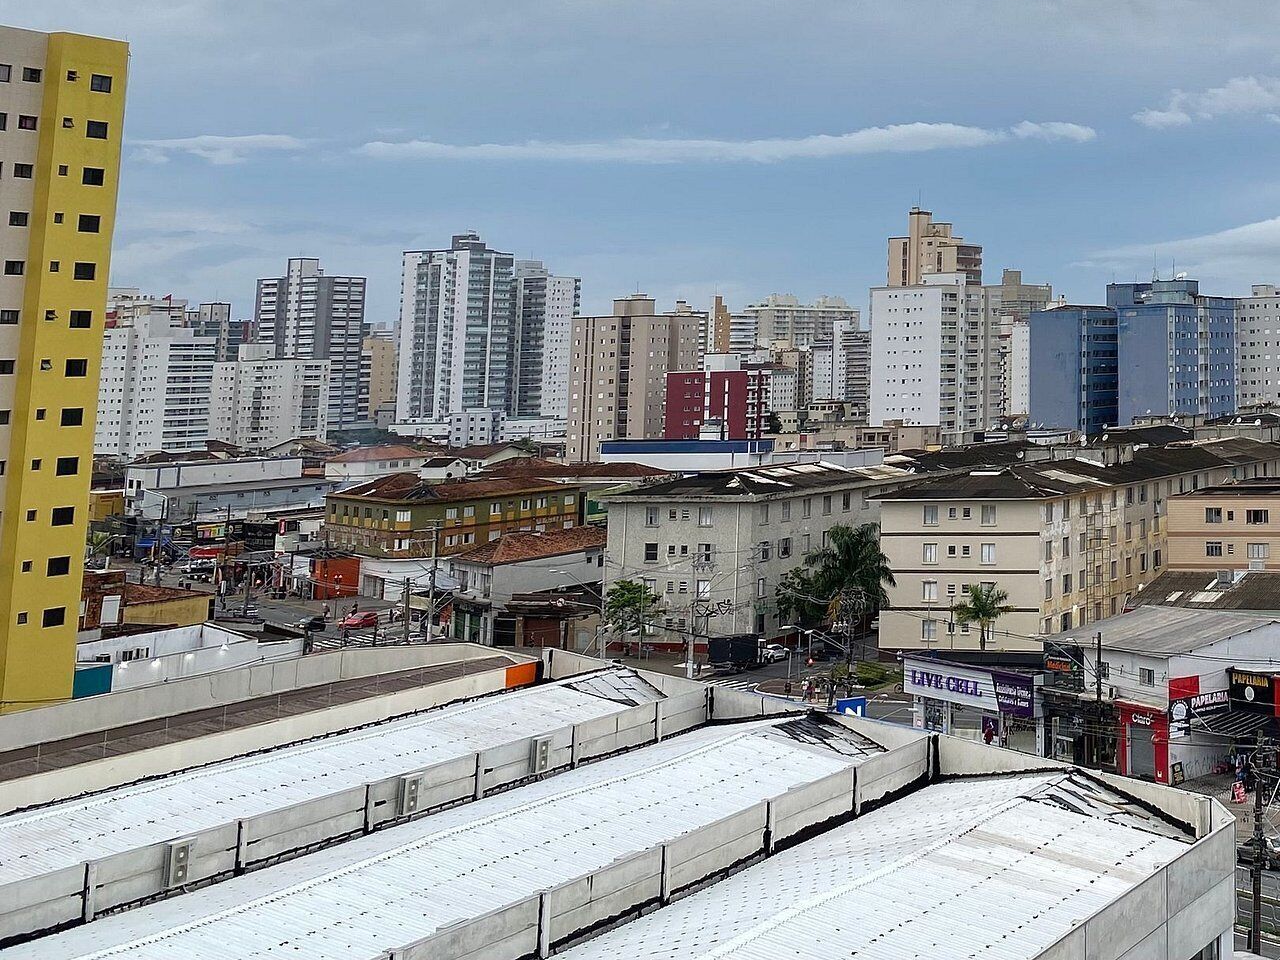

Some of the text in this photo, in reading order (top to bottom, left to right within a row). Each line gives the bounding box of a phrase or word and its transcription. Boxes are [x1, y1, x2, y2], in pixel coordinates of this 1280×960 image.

[911, 670, 982, 697] LIVE CELL
[1232, 672, 1269, 688] PAPELARIA
[1191, 692, 1228, 708] PAPELARIA
[1132, 713, 1151, 725] Claro
